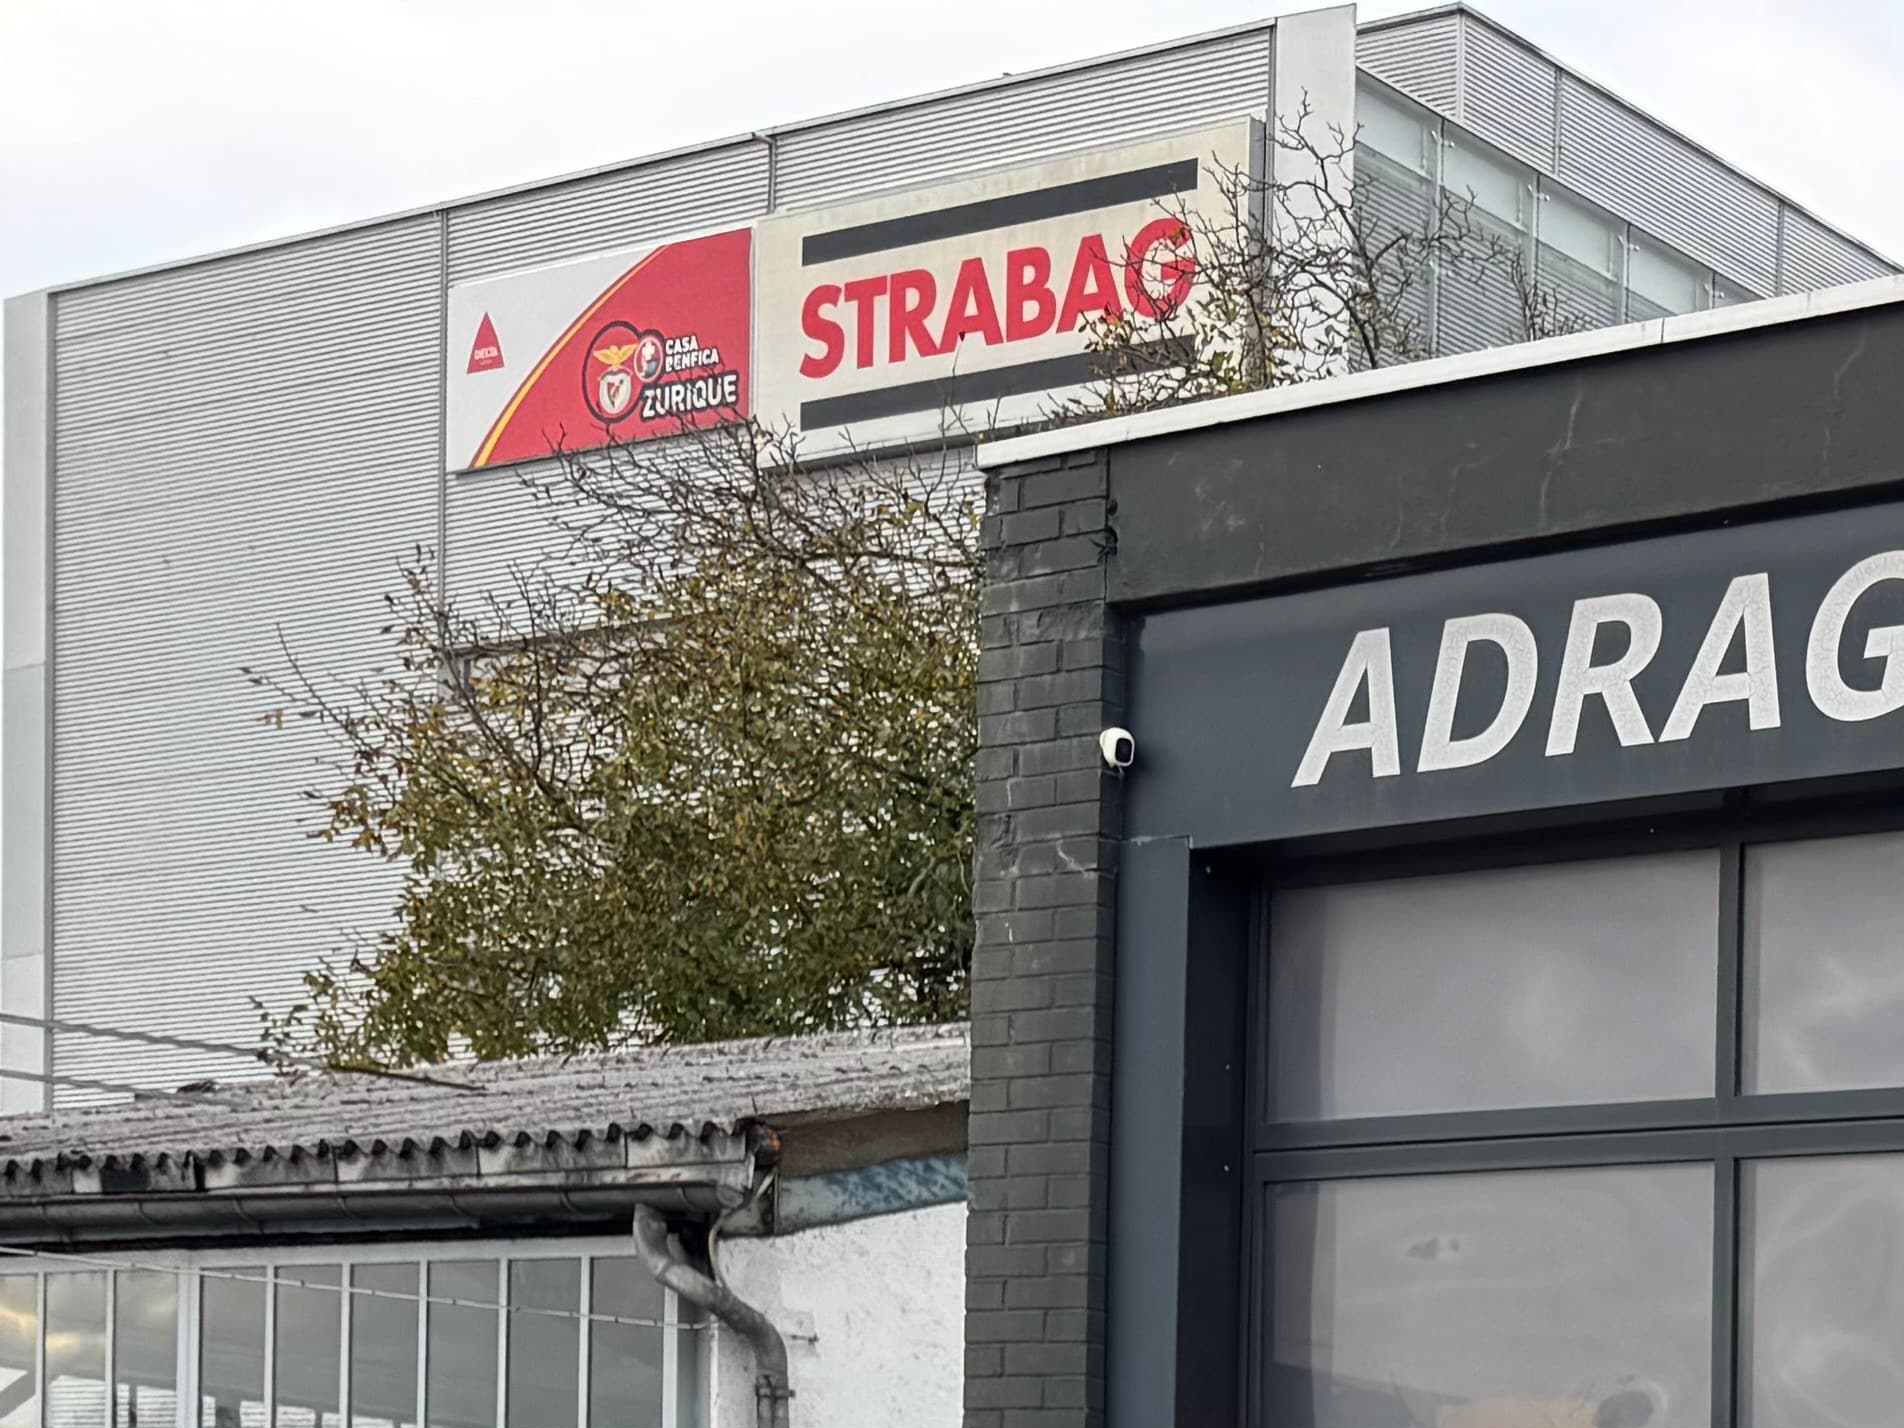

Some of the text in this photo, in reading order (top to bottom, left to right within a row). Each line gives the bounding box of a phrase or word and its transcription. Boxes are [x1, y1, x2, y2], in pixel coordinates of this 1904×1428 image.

[799, 216, 1199, 379] STRABAG
[665, 335, 699, 355] CASA
[665, 348, 720, 372] BENFICA
[643, 374, 738, 418] ZURIQUE
